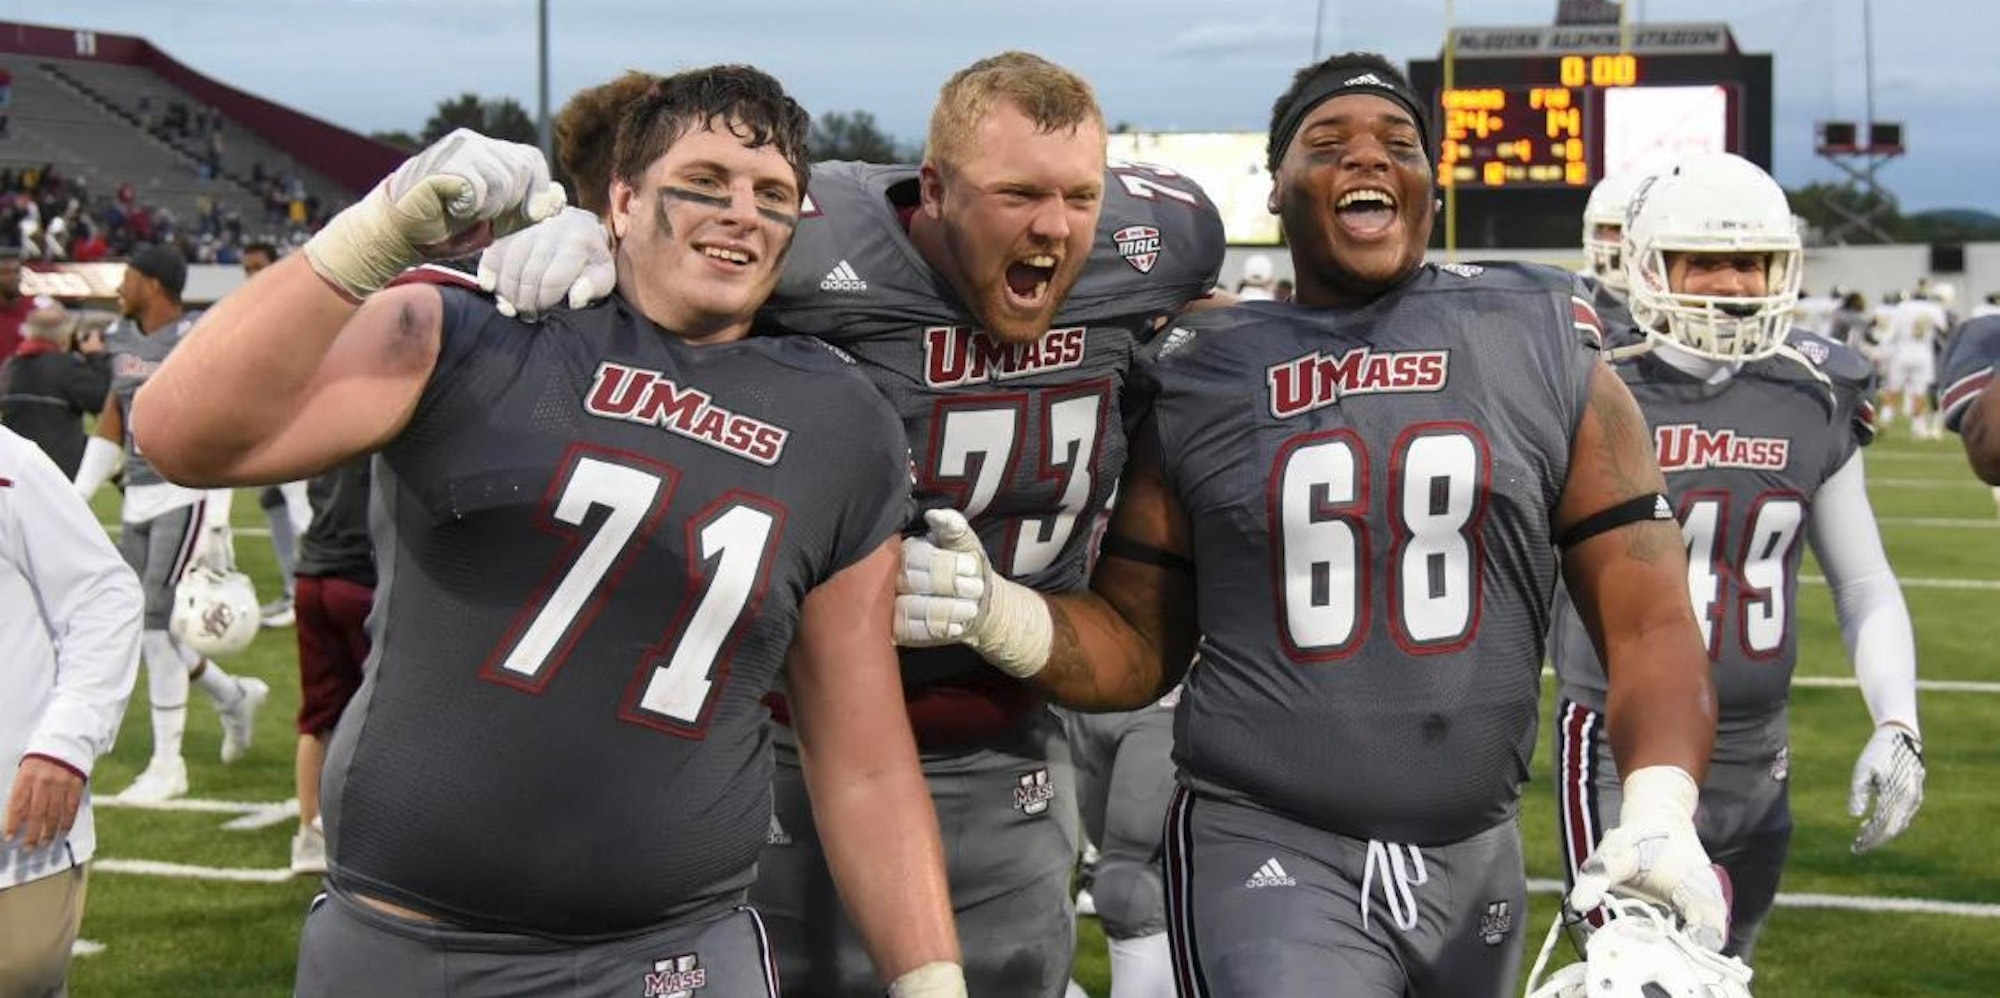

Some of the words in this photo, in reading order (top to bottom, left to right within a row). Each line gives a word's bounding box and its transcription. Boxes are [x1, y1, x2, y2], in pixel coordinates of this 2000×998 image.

[1119, 238, 1161, 256] MAC
[925, 327, 1087, 388] UMASS
[1267, 348, 1449, 417] UMASS
[586, 362, 787, 464] UMASS
[1655, 425, 1788, 471] UMASS
[932, 386, 1106, 578] 73
[490, 448, 781, 732] 71
[1275, 427, 1484, 654] 68
[1680, 496, 1804, 655] 49
